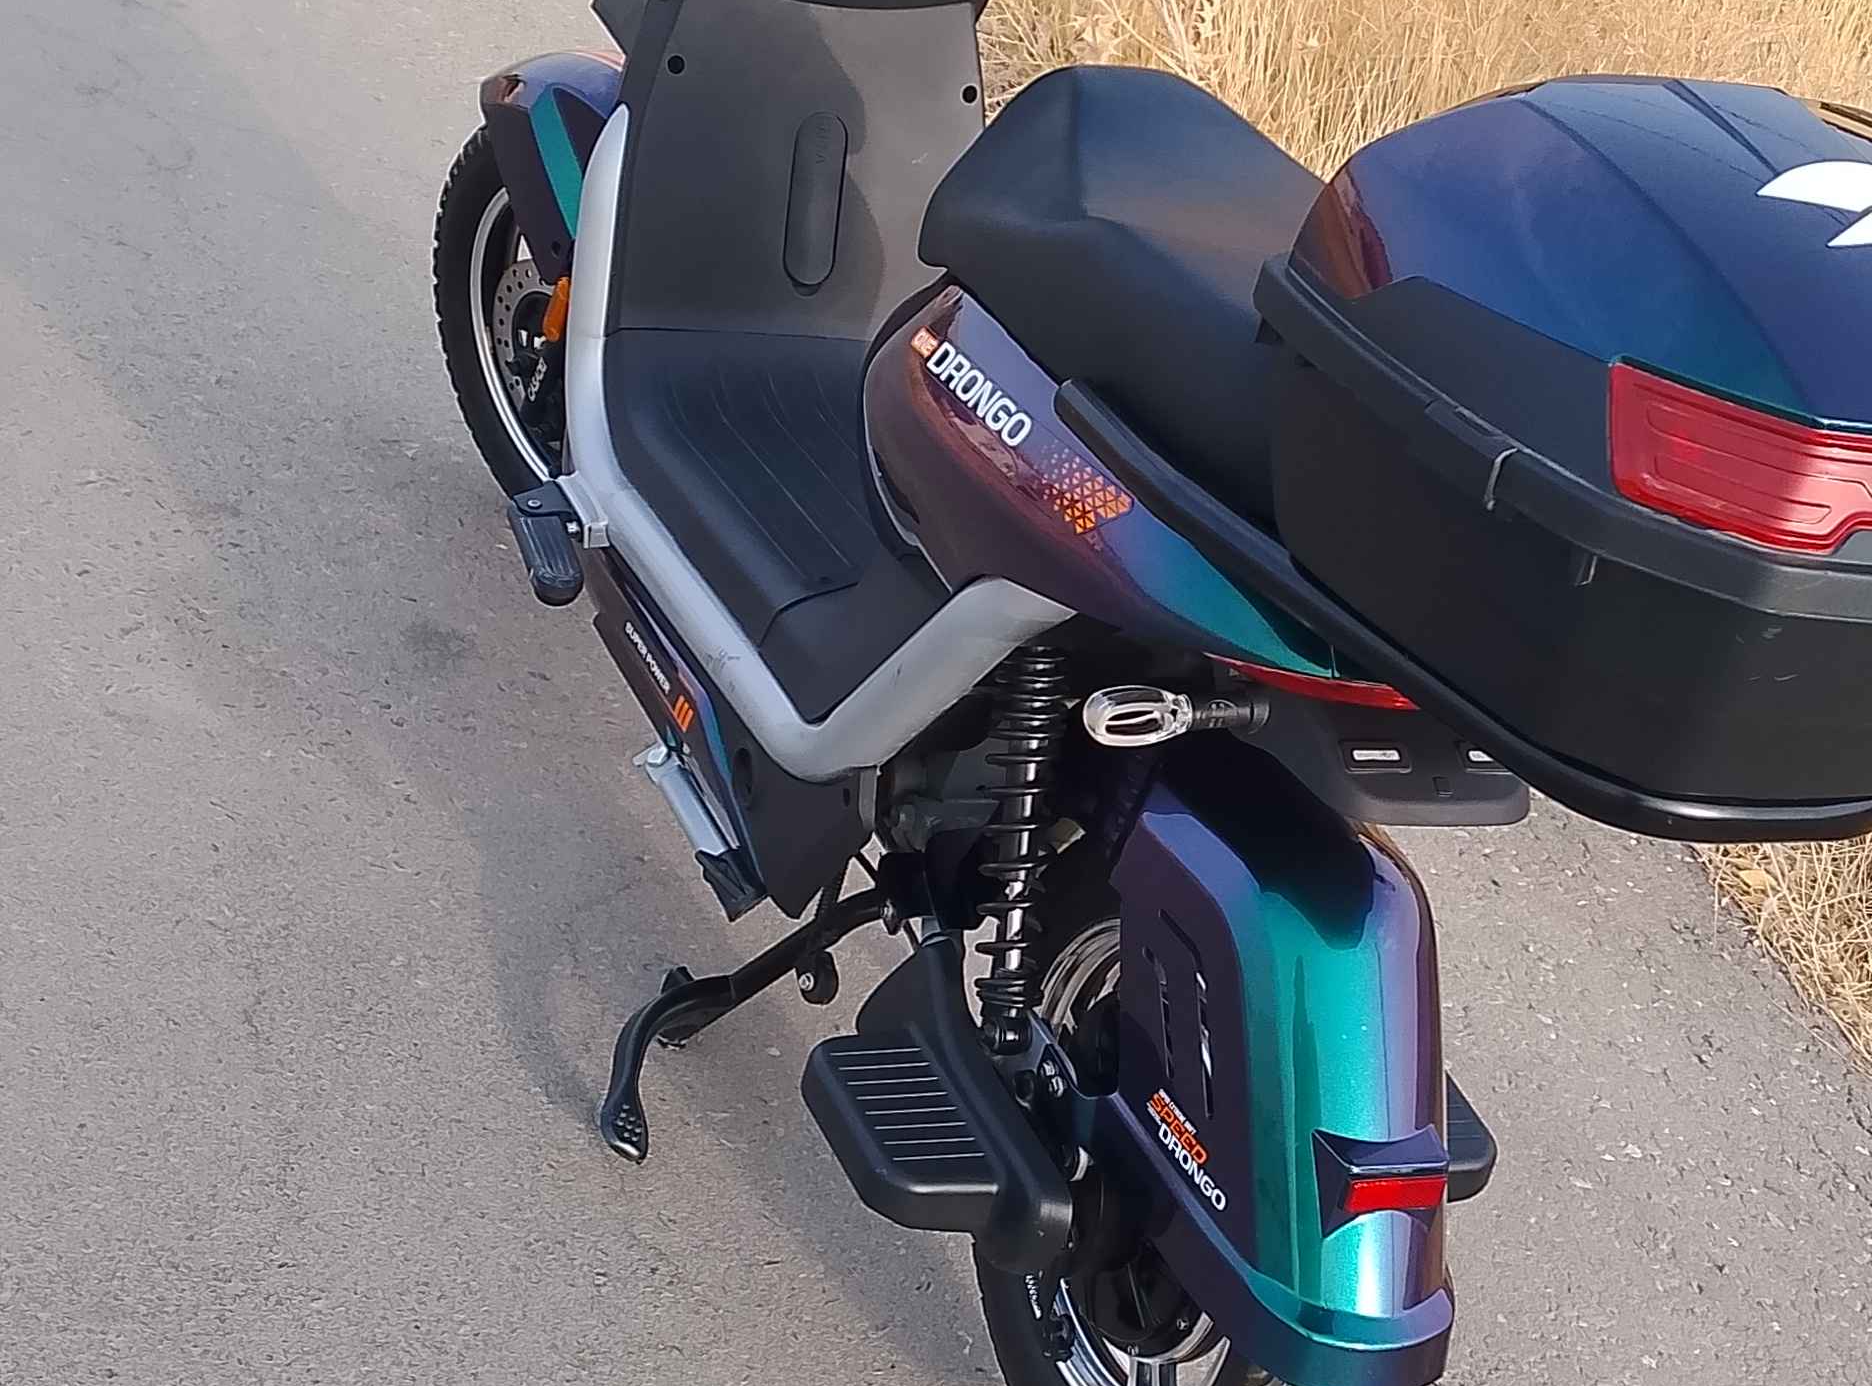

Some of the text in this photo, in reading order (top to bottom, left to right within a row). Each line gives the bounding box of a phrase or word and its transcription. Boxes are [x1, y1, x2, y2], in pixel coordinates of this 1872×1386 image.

[926, 341, 1032, 446] DRONGO
[645, 652, 671, 695] POWER
[1150, 1093, 1208, 1165] SPEED
[1158, 1122, 1226, 1211] DRONGO
